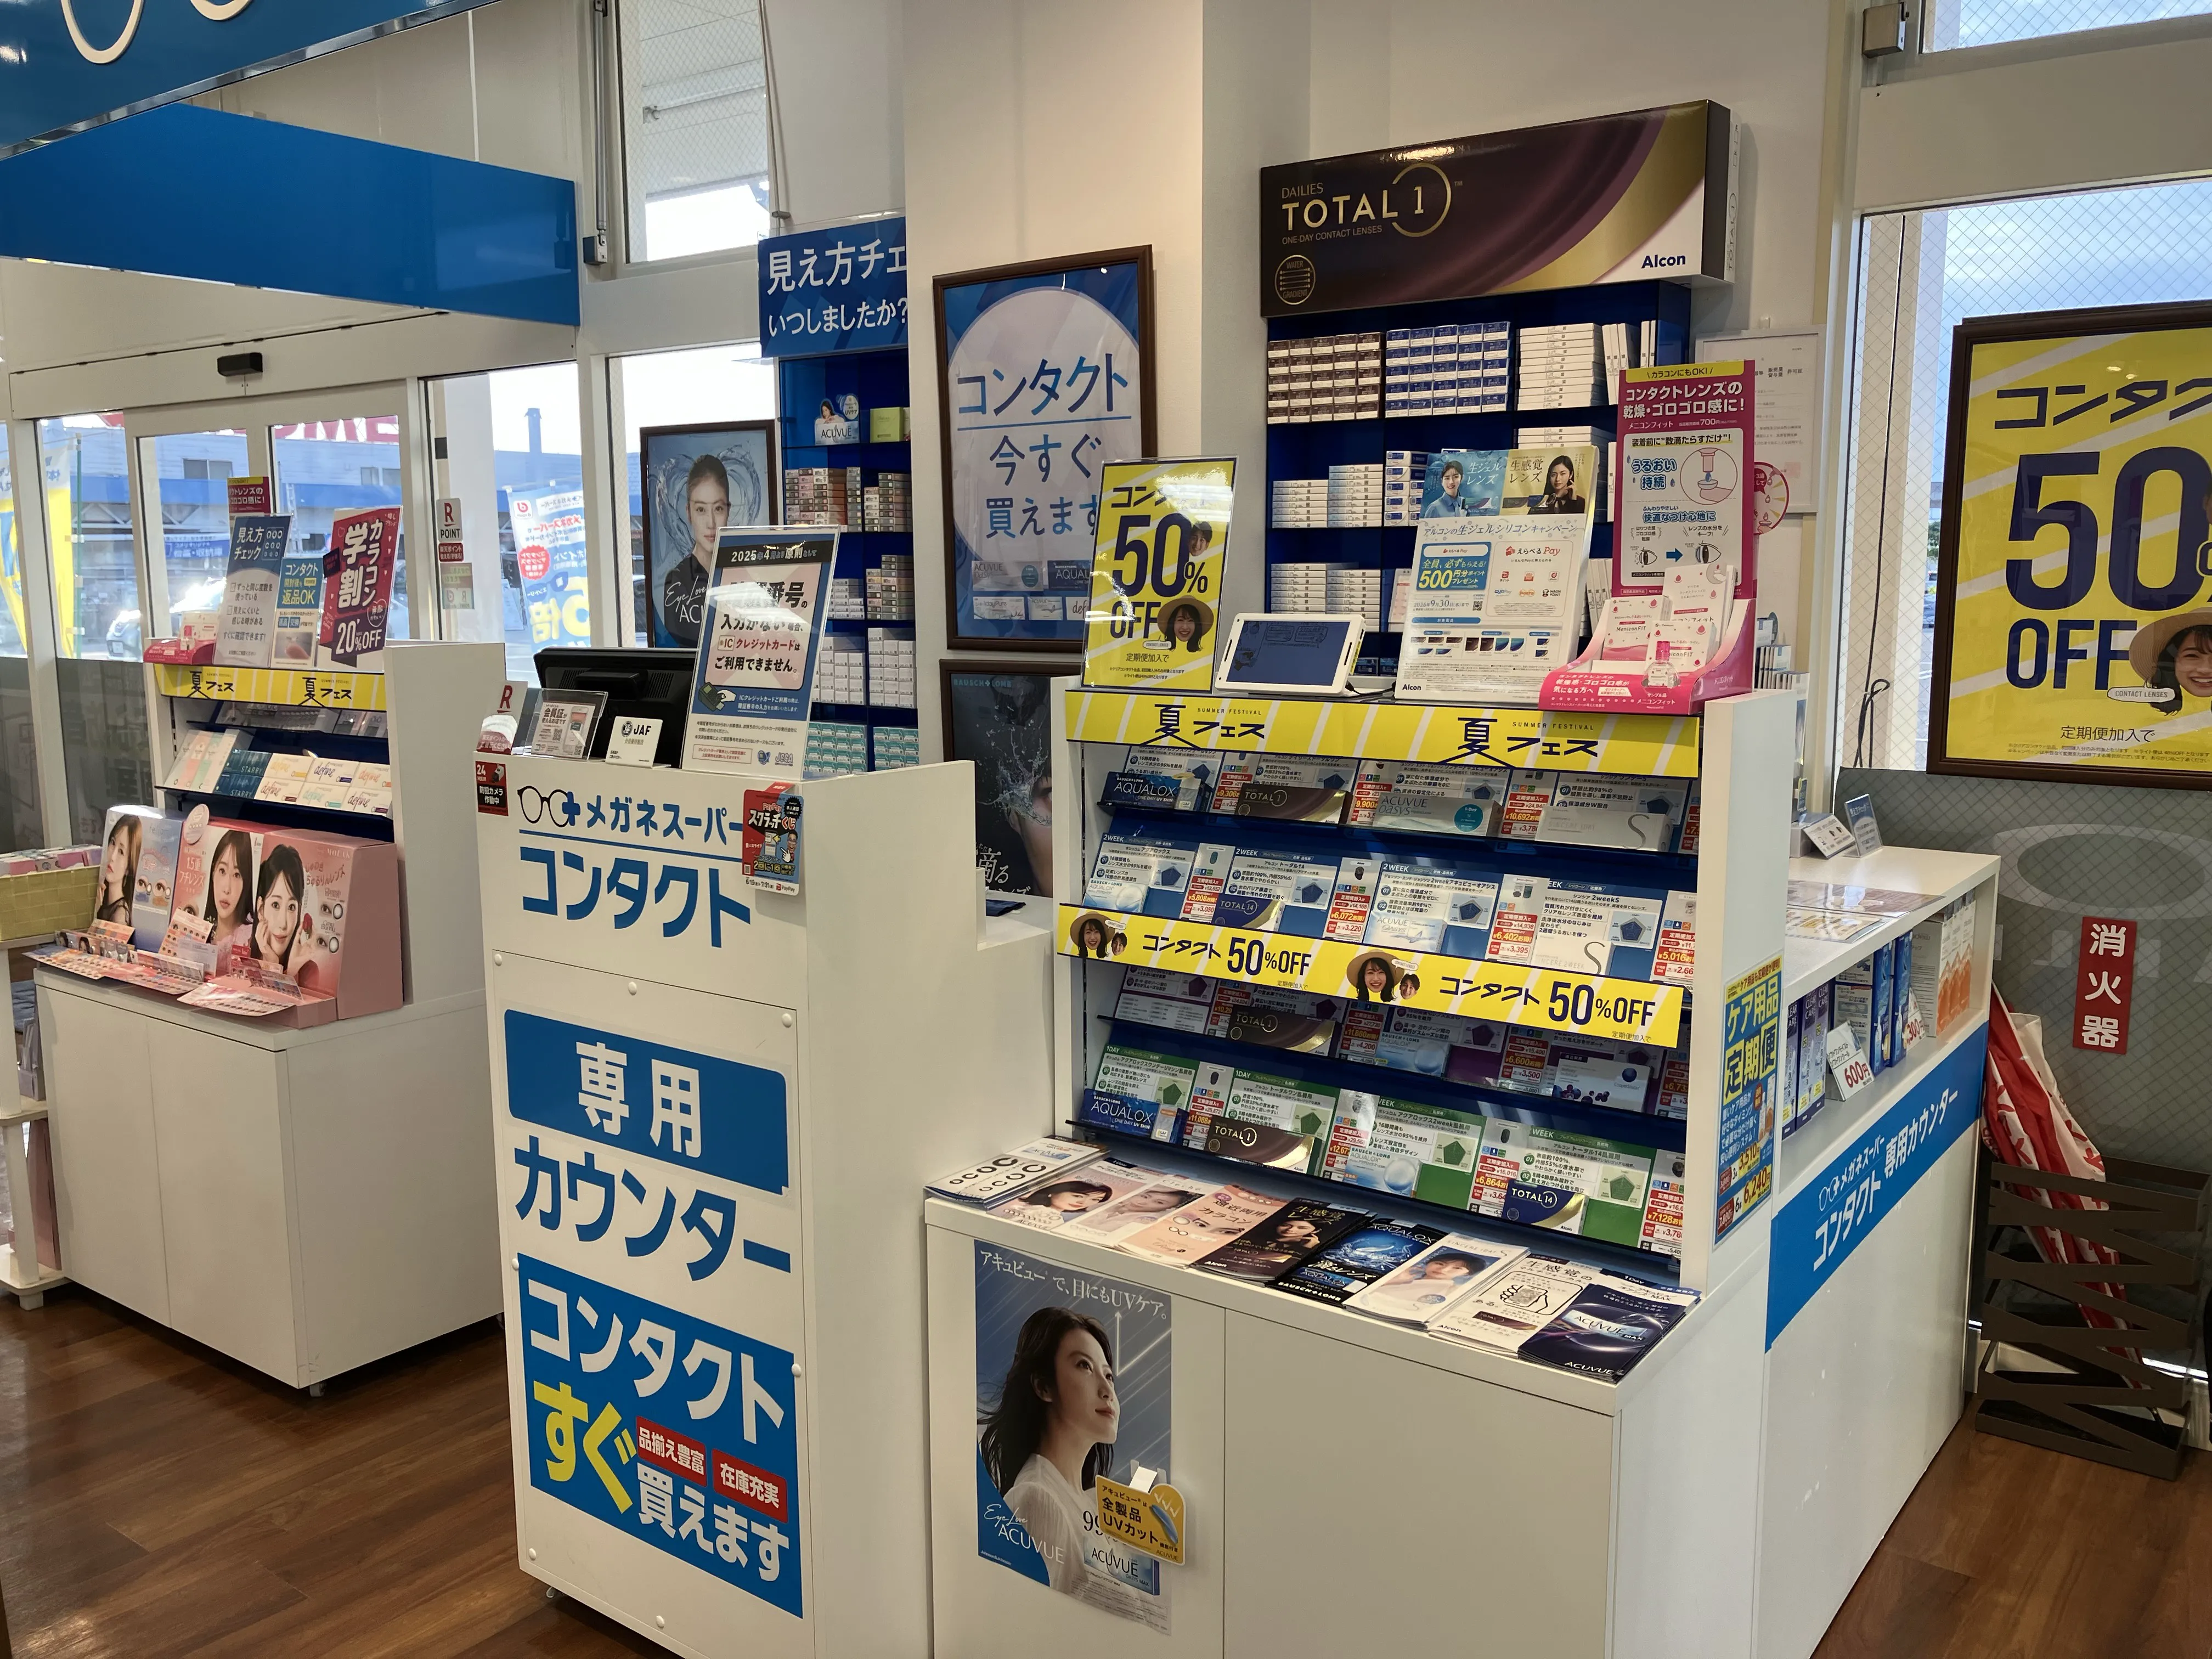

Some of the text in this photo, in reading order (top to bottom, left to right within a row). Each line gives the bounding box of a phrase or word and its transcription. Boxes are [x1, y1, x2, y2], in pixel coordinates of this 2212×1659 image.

[1282, 183, 1323, 199] DAILIES
[1282, 186, 1424, 231] TOTAL 1
[1282, 225, 1383, 245] ONE-DAY CONTACT LENSES
[1286, 260, 1304, 269] WATER
[1641, 253, 1686, 269] Alcon
[1282, 289, 1308, 300] GRADIENT
[769, 297, 907, 337] いつしましたか?
[1651, 368, 1707, 379] カラコンにもOK!
[957, 353, 1128, 416] コンタクト
[1626, 381, 1742, 402] コンタクトレンズの
[1623, 398, 1745, 419] 乾燥・ゴロゴロ感に!
[821, 427, 852, 438] ACUVUE
[1628, 421, 1673, 430] メニコンフィット
[990, 433, 1102, 486] 今すぐ
[1510, 459, 1543, 472] 生感覚
[1631, 459, 1677, 472] うるおい
[1466, 473, 1497, 486] レンズ
[1510, 472, 1541, 483] レンズ
[1640, 475, 1666, 490] 持続
[444, 503, 455, 523] R
[1643, 511, 1716, 523] 快適なつけ心地に
[236, 527, 264, 544] 見え方
[441, 528, 461, 539] POINT
[234, 546, 262, 561] チェック
[1543, 546, 1560, 557] Pay
[285, 563, 319, 576] コンタクト
[338, 522, 368, 609] 学割
[362, 518, 383, 607] カラコン
[974, 563, 1003, 572] ACUVUE
[1418, 569, 1453, 589] 500
[281, 589, 316, 605] 返品OK
[665, 575, 707, 613] Eye Love
[1125, 653, 1170, 663] 定期便加入で
[2006, 618, 2137, 691] OFF
[714, 656, 797, 673] ご利用できません。
[188, 671, 234, 699] 夏フェス
[298, 677, 352, 707] 夏フェス
[1553, 686, 1594, 694] 気になる方へ
[2114, 689, 2168, 698] CONTACT LENSES
[499, 685, 513, 709] R
[634, 724, 652, 736] JAF
[1140, 704, 1265, 751] 夏フェス
[2060, 725, 2155, 743] 定期便加入で
[1440, 717, 1599, 768] 夏フェス
[477, 764, 486, 776] 24
[479, 786, 504, 797] 防犯カメラ
[1114, 782, 1177, 797] AQUALOX
[1245, 791, 1273, 801] TOTAL
[484, 795, 500, 805] 作動中
[763, 802, 782, 812] PayPay
[1381, 796, 1429, 808] ACUVUE
[587, 794, 743, 845] メガネスーパー
[1103, 834, 1124, 842] 2WEEK
[1384, 864, 1409, 872] 2WEEK
[520, 847, 751, 949] コンタクト
[1220, 900, 1245, 911] TOTAL
[1592, 894, 1620, 903] 2weekS
[1376, 917, 1408, 927] ACUVUE
[1143, 934, 1312, 976] コンタクト 50%OFF
[2083, 923, 2127, 1048] 消火器
[1440, 976, 1656, 1026] コンタクト 50%OFF
[1727, 975, 1779, 1043] ケア用品
[1611, 1031, 1652, 1043] 定期便加入で
[1107, 1046, 1120, 1054] 1DAY
[1725, 1023, 1777, 1100] 定期便
[1236, 1070, 1251, 1079] 1DAY
[1844, 1060, 1870, 1088] 600円
[575, 1041, 702, 1158] 専用
[1091, 1101, 1154, 1123] AQUALOX
[1215, 1126, 1243, 1141] TOTAL
[1884, 1088, 1959, 1179] 専用カウンター
[1839, 1134, 1885, 1193] メガネスーパー
[1511, 1188, 1554, 1204] TOTAL 14
[514, 1135, 791, 1282] カウンター
[1199, 1207, 1252, 1225] カラコン
[1213, 1198, 1268, 1217] 遠近両用
[1813, 1171, 1881, 1272] コンタクト
[1368, 1223, 1438, 1245] AQUALOX
[1439, 1324, 1462, 1333] Alcon
[1574, 1314, 1626, 1334] ACUVUE
[528, 1278, 785, 1444] コンタクト
[1564, 1361, 1613, 1375] ACUVUE
[533, 1380, 637, 1514] すぐ
[639, 1426, 706, 1476] 品揃え豊富
[720, 1463, 780, 1509] 在庫充実
[1102, 1497, 1142, 1523] 全製品
[637, 1463, 789, 1582] 買えます
[1103, 1512, 1159, 1544] UVカット
[998, 1523, 1065, 1565] ACUVUE
[1091, 1547, 1139, 1578] ACUVUE
[1156, 1550, 1179, 1562] ACUVUE
